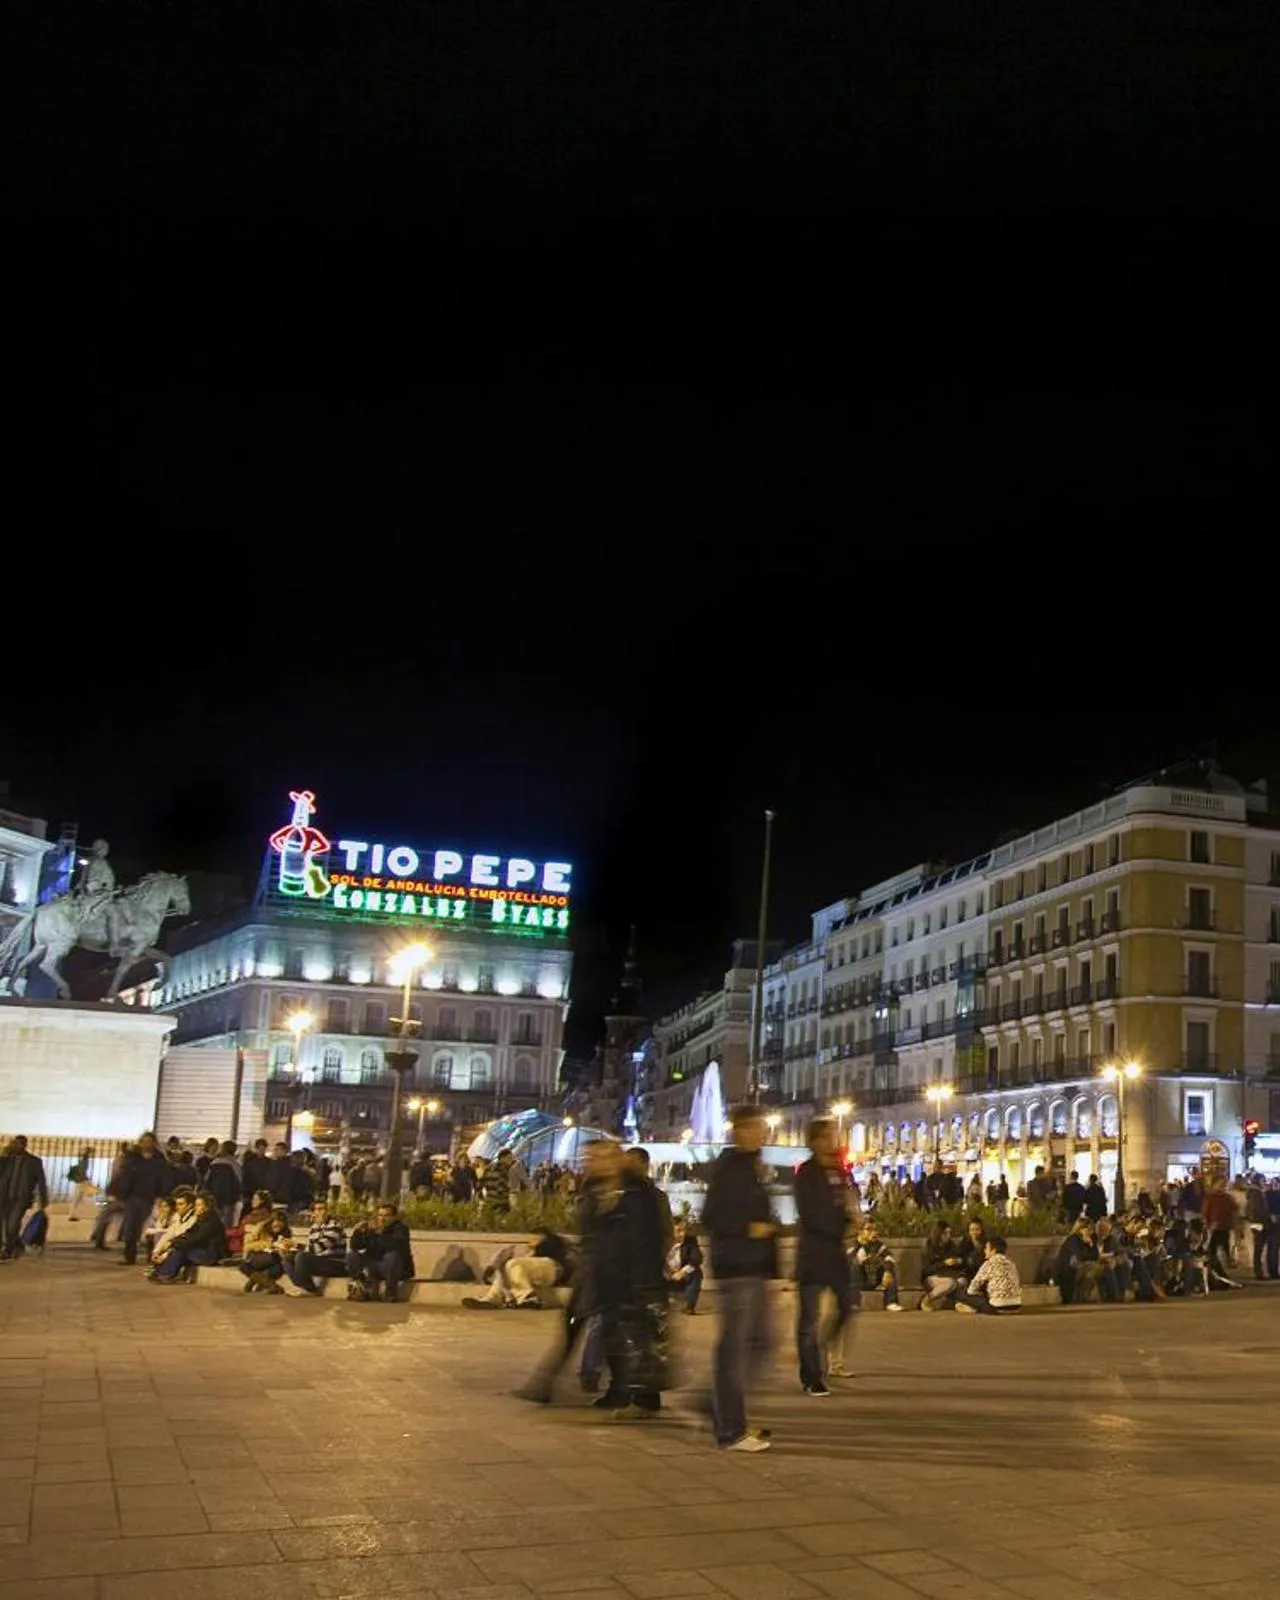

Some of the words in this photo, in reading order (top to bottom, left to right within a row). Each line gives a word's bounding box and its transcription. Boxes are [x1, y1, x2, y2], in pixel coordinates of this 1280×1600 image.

[338, 840, 419, 876] TIO
[433, 850, 572, 893] PEPE
[330, 874, 359, 886] SOL
[363, 877, 382, 888] DE
[385, 879, 465, 897] ANDALUCIA
[469, 888, 567, 906] EMBOTELLADO
[333, 883, 466, 919] GONZALEZ
[491, 898, 569, 928] BYASS
